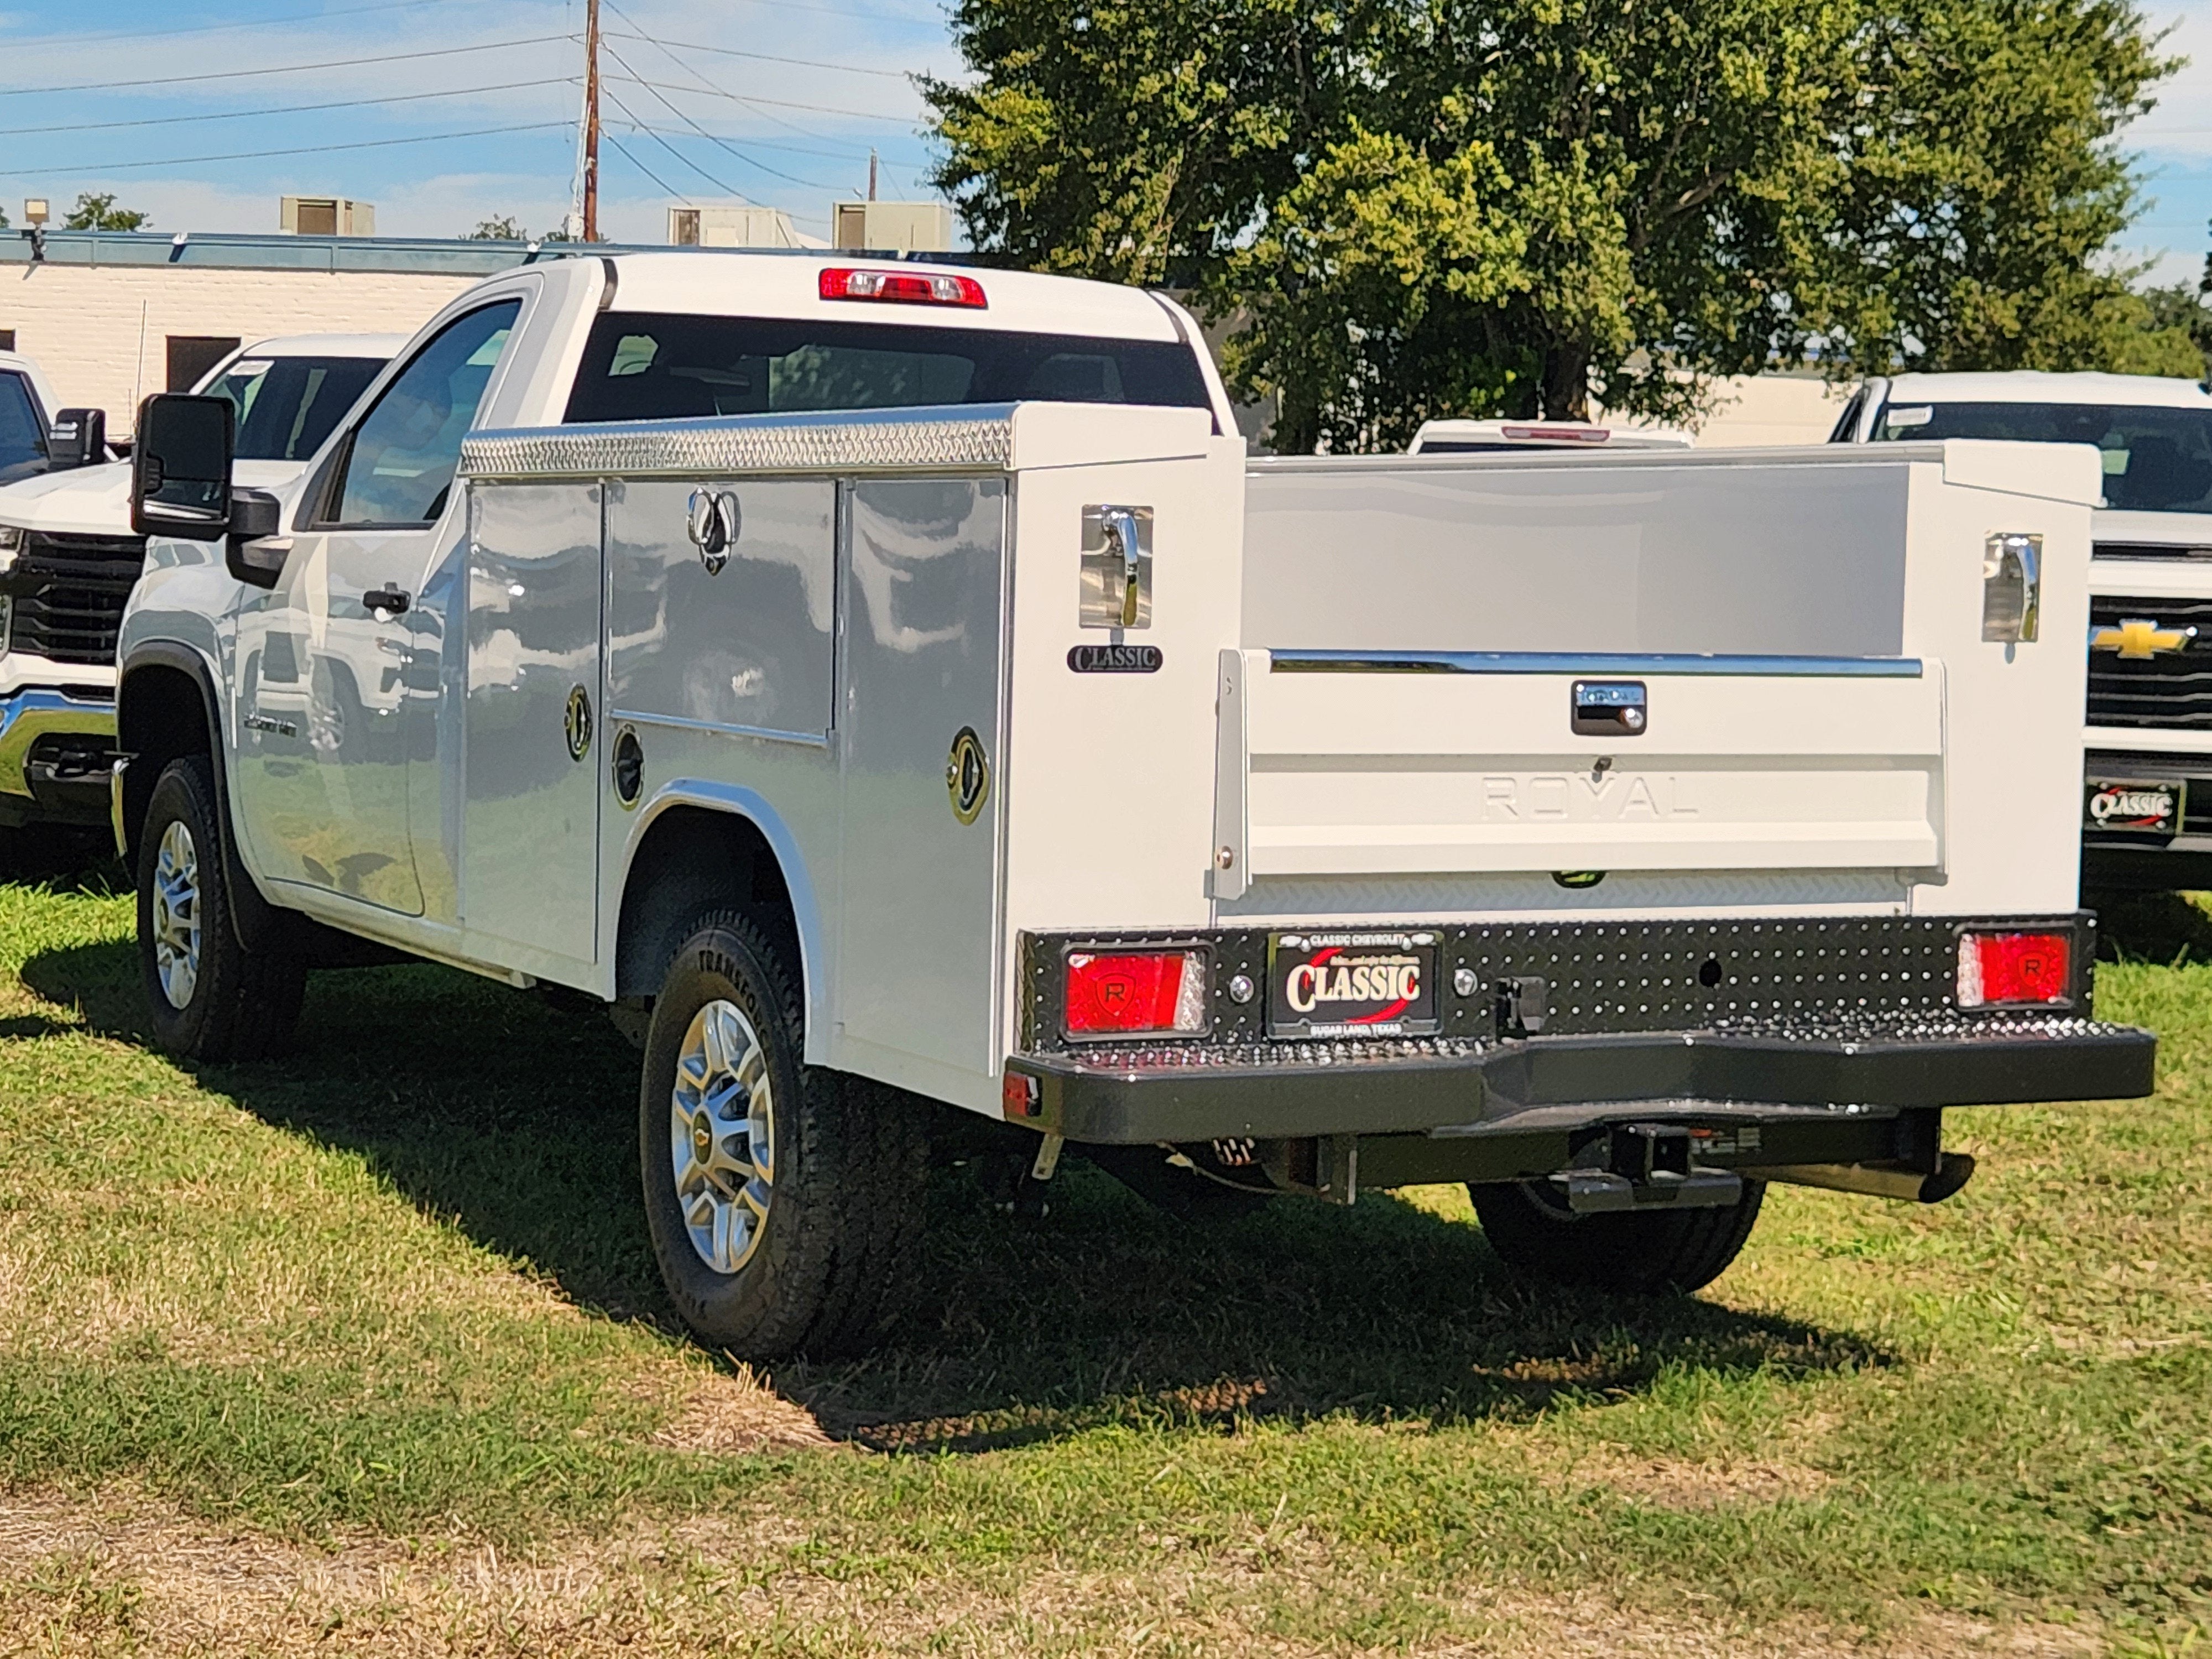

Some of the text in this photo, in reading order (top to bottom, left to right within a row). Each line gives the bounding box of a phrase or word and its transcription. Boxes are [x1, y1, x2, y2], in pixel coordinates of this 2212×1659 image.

[1074, 647, 1156, 671] CLASSIC
[1481, 775, 1699, 820] ROYAL
[2090, 792, 2173, 819] CLASSIC
[1310, 934, 1351, 946] CLASSIC
[2024, 958, 2042, 981] R
[1105, 982, 1125, 1003] R
[1286, 964, 1421, 1013] CLASSIC
[1371, 1023, 1402, 1036] TEXAS
